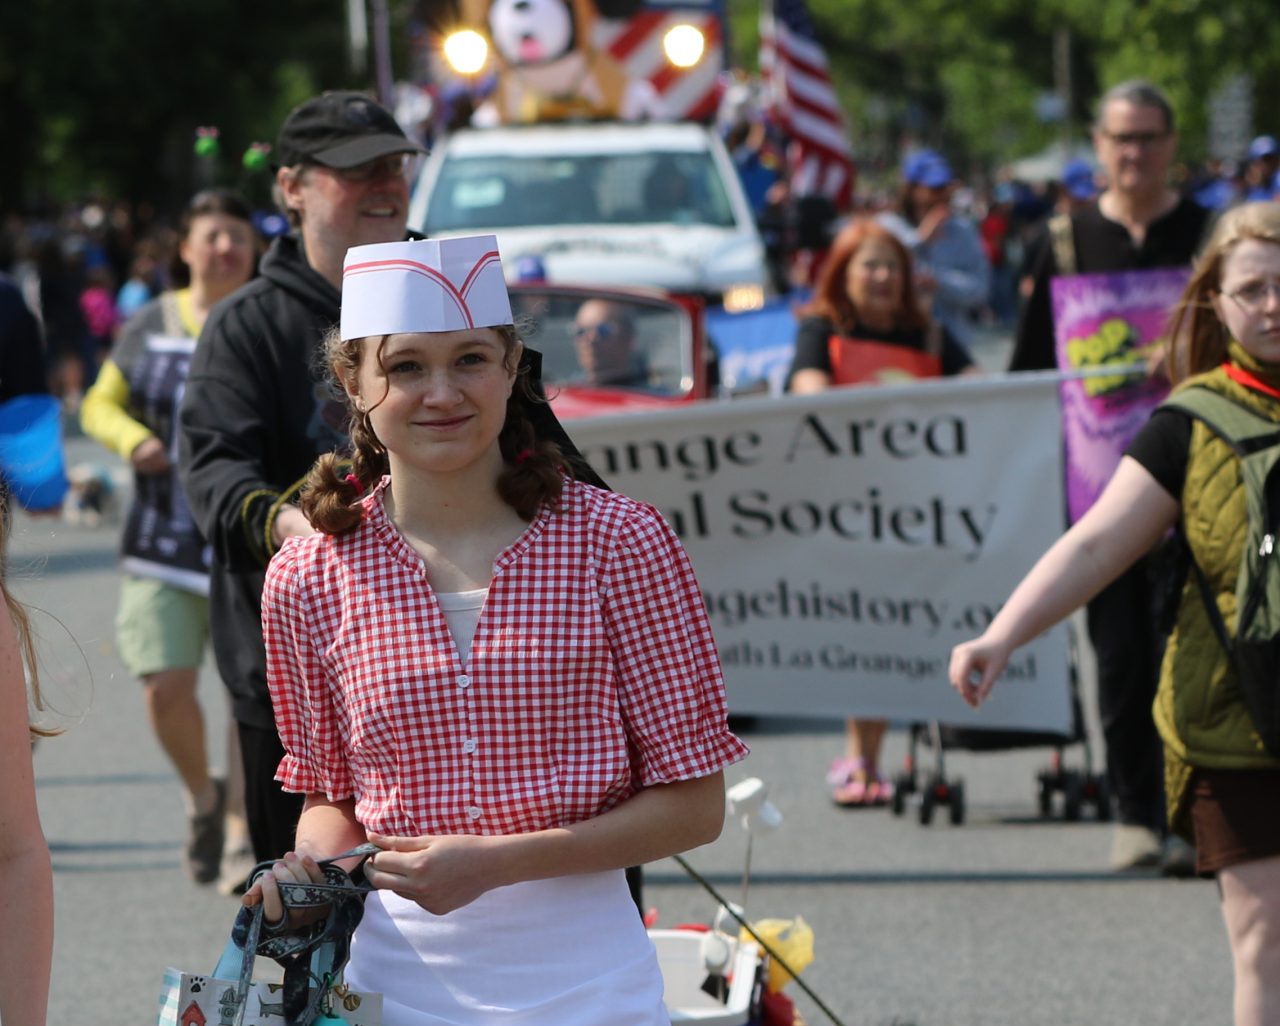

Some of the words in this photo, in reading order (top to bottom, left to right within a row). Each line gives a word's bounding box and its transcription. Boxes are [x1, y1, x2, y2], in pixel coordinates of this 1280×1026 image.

[581, 429, 763, 481] ange
[786, 411, 968, 463] Area
[729, 488, 998, 563] Society
[771, 641, 814, 669] La
